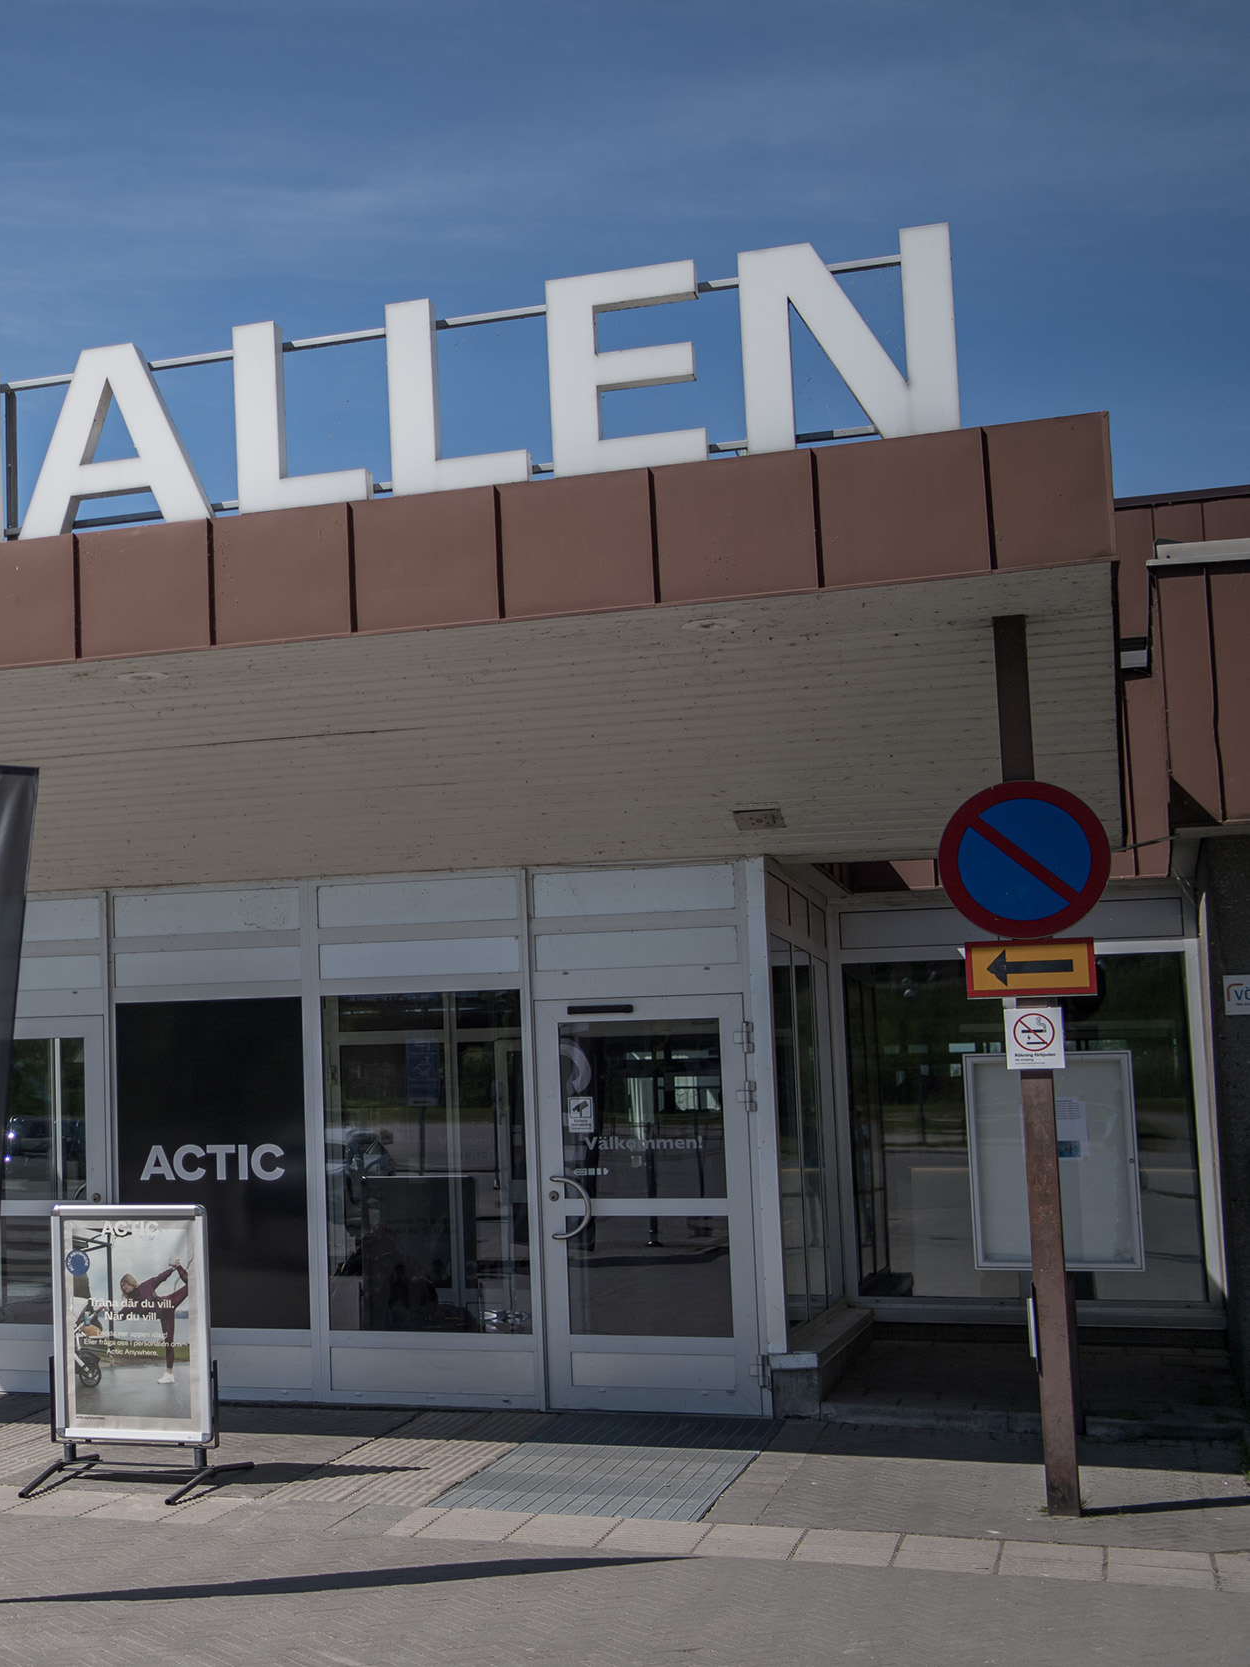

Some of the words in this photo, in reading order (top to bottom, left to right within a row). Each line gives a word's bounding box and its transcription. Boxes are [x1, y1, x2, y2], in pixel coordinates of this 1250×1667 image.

[584, 1135, 703, 1151] Välkommen!
[139, 1143, 286, 1182] ACTIC
[101, 1221, 159, 1237] ACTIC
[89, 1297, 119, 1308] Träna
[121, 1298, 138, 1308] där
[141, 1298, 155, 1309] du
[157, 1299, 175, 1309] vill.
[104, 1311, 125, 1321] När
[126, 1311, 140, 1321] du
[142, 1312, 161, 1321] vill.
[98, 1338, 116, 1347] fråga
[133, 1339, 169, 1348] personalen
[124, 1348, 159, 1357] Anywhere.
